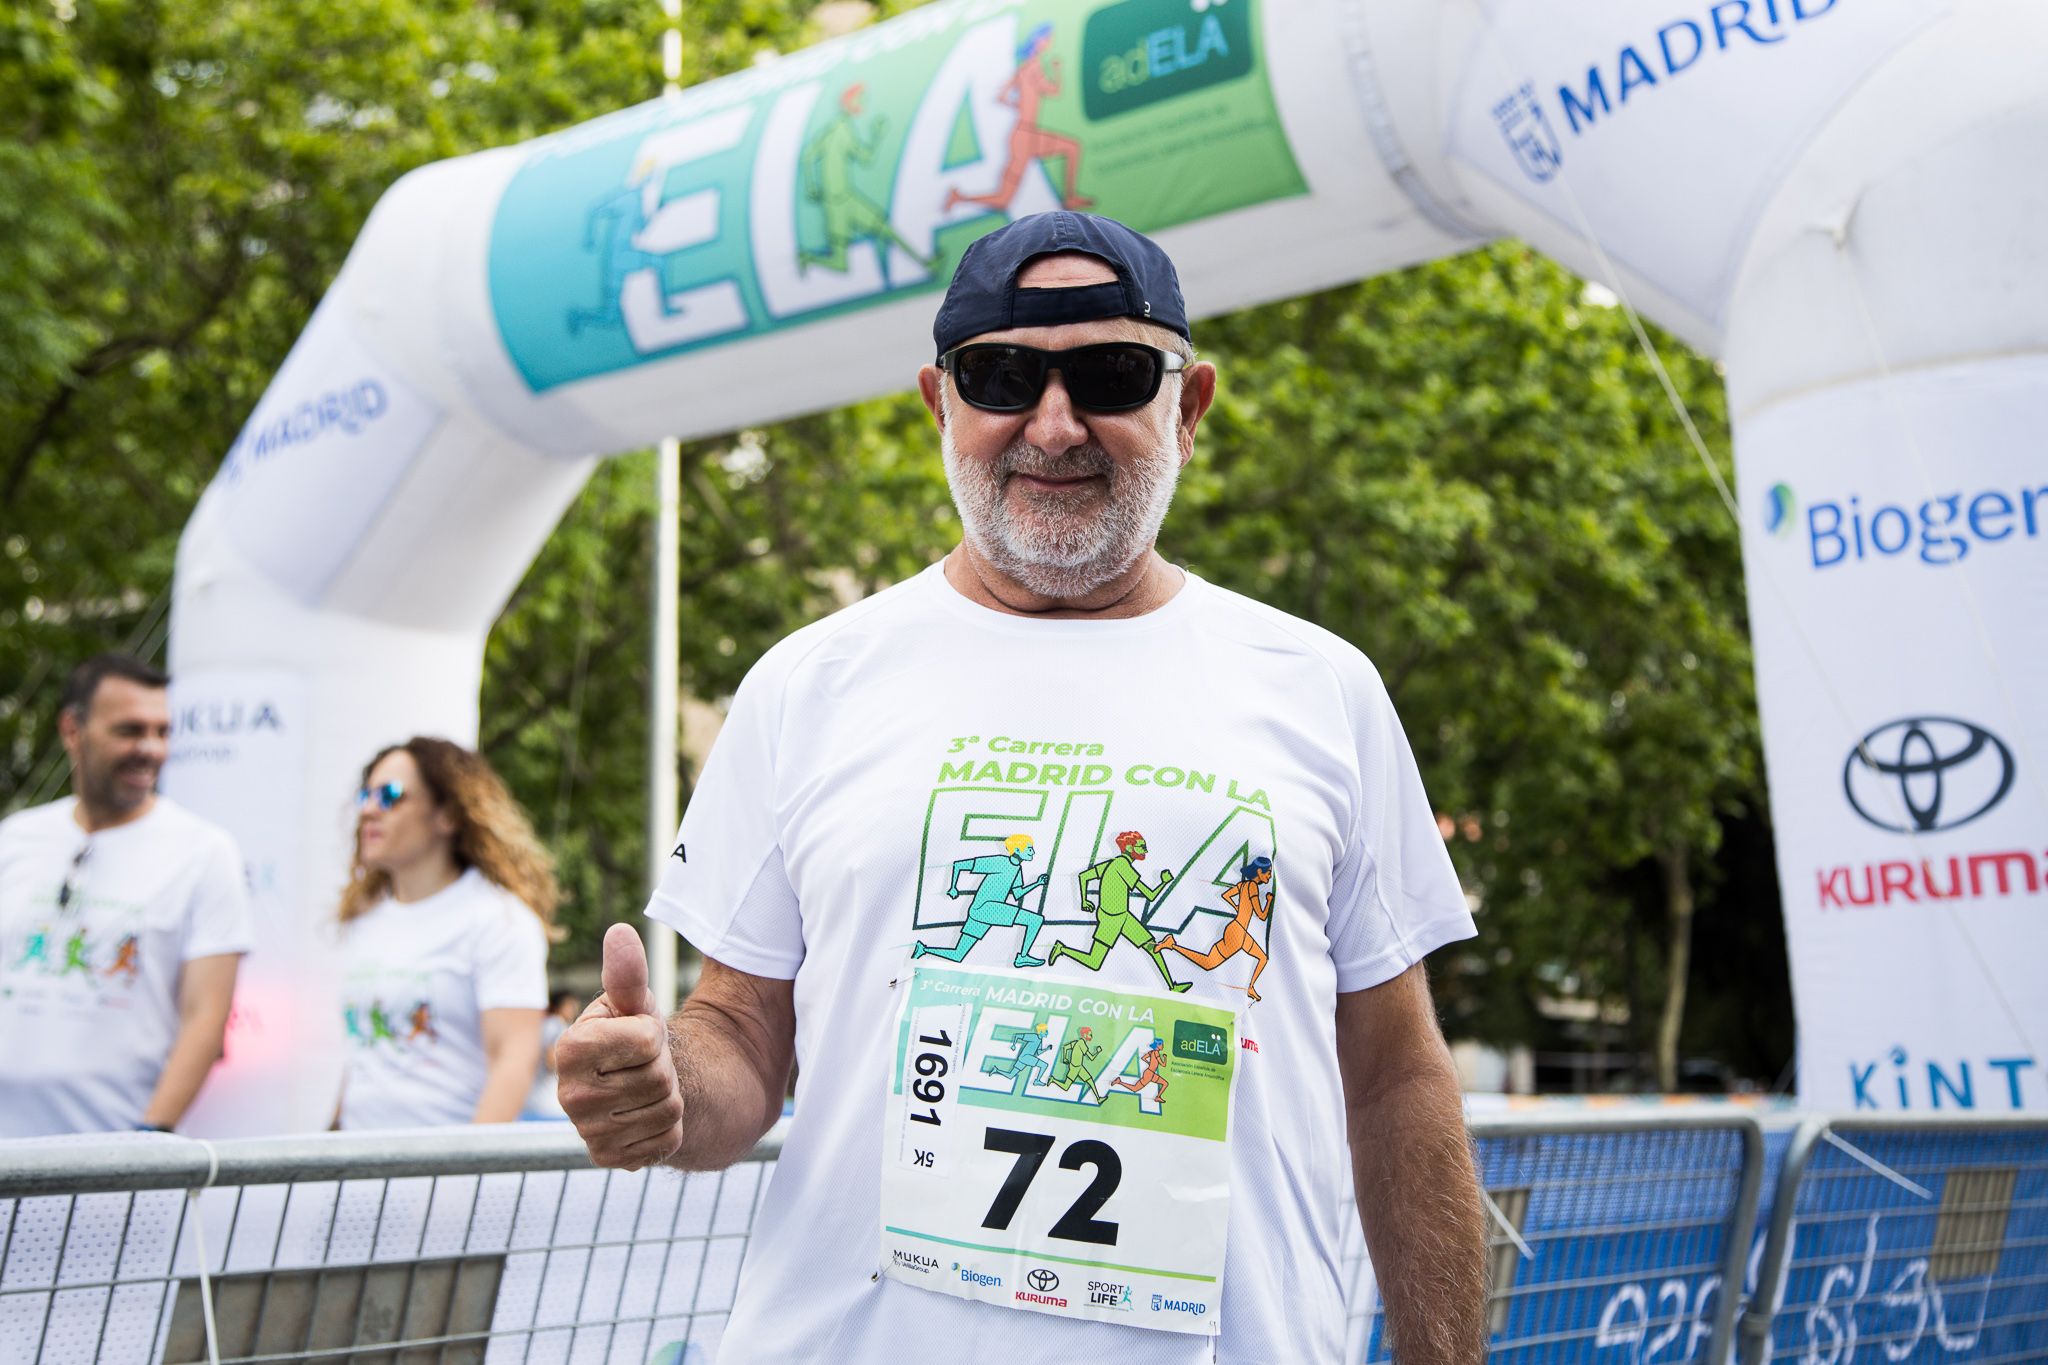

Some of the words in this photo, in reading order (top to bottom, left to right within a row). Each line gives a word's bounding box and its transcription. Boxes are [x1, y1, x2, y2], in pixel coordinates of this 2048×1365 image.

[987, 735, 1105, 757] Carrera
[937, 760, 1113, 787] MADRID
[1124, 764, 1216, 794] CON
[1227, 780, 1272, 812] LA
[912, 786, 1278, 960] ELA
[934, 981, 980, 997] Carrera
[984, 986, 1073, 1011] MADRID
[1078, 999, 1123, 1020] CON
[1128, 1006, 1155, 1024] LA
[1180, 1038, 1221, 1056] adELA
[959, 1005, 1162, 1116] ELA
[910, 1029, 952, 1127] 1691
[913, 1148, 935, 1168] 5K
[980, 1126, 1122, 1247] 72
[893, 1250, 940, 1269] MUKUA
[961, 1269, 1002, 1288] Biogen
[1087, 1280, 1124, 1295] SPORT
[1090, 1292, 1118, 1307] LIFE
[1164, 1299, 1206, 1316] MADRID
